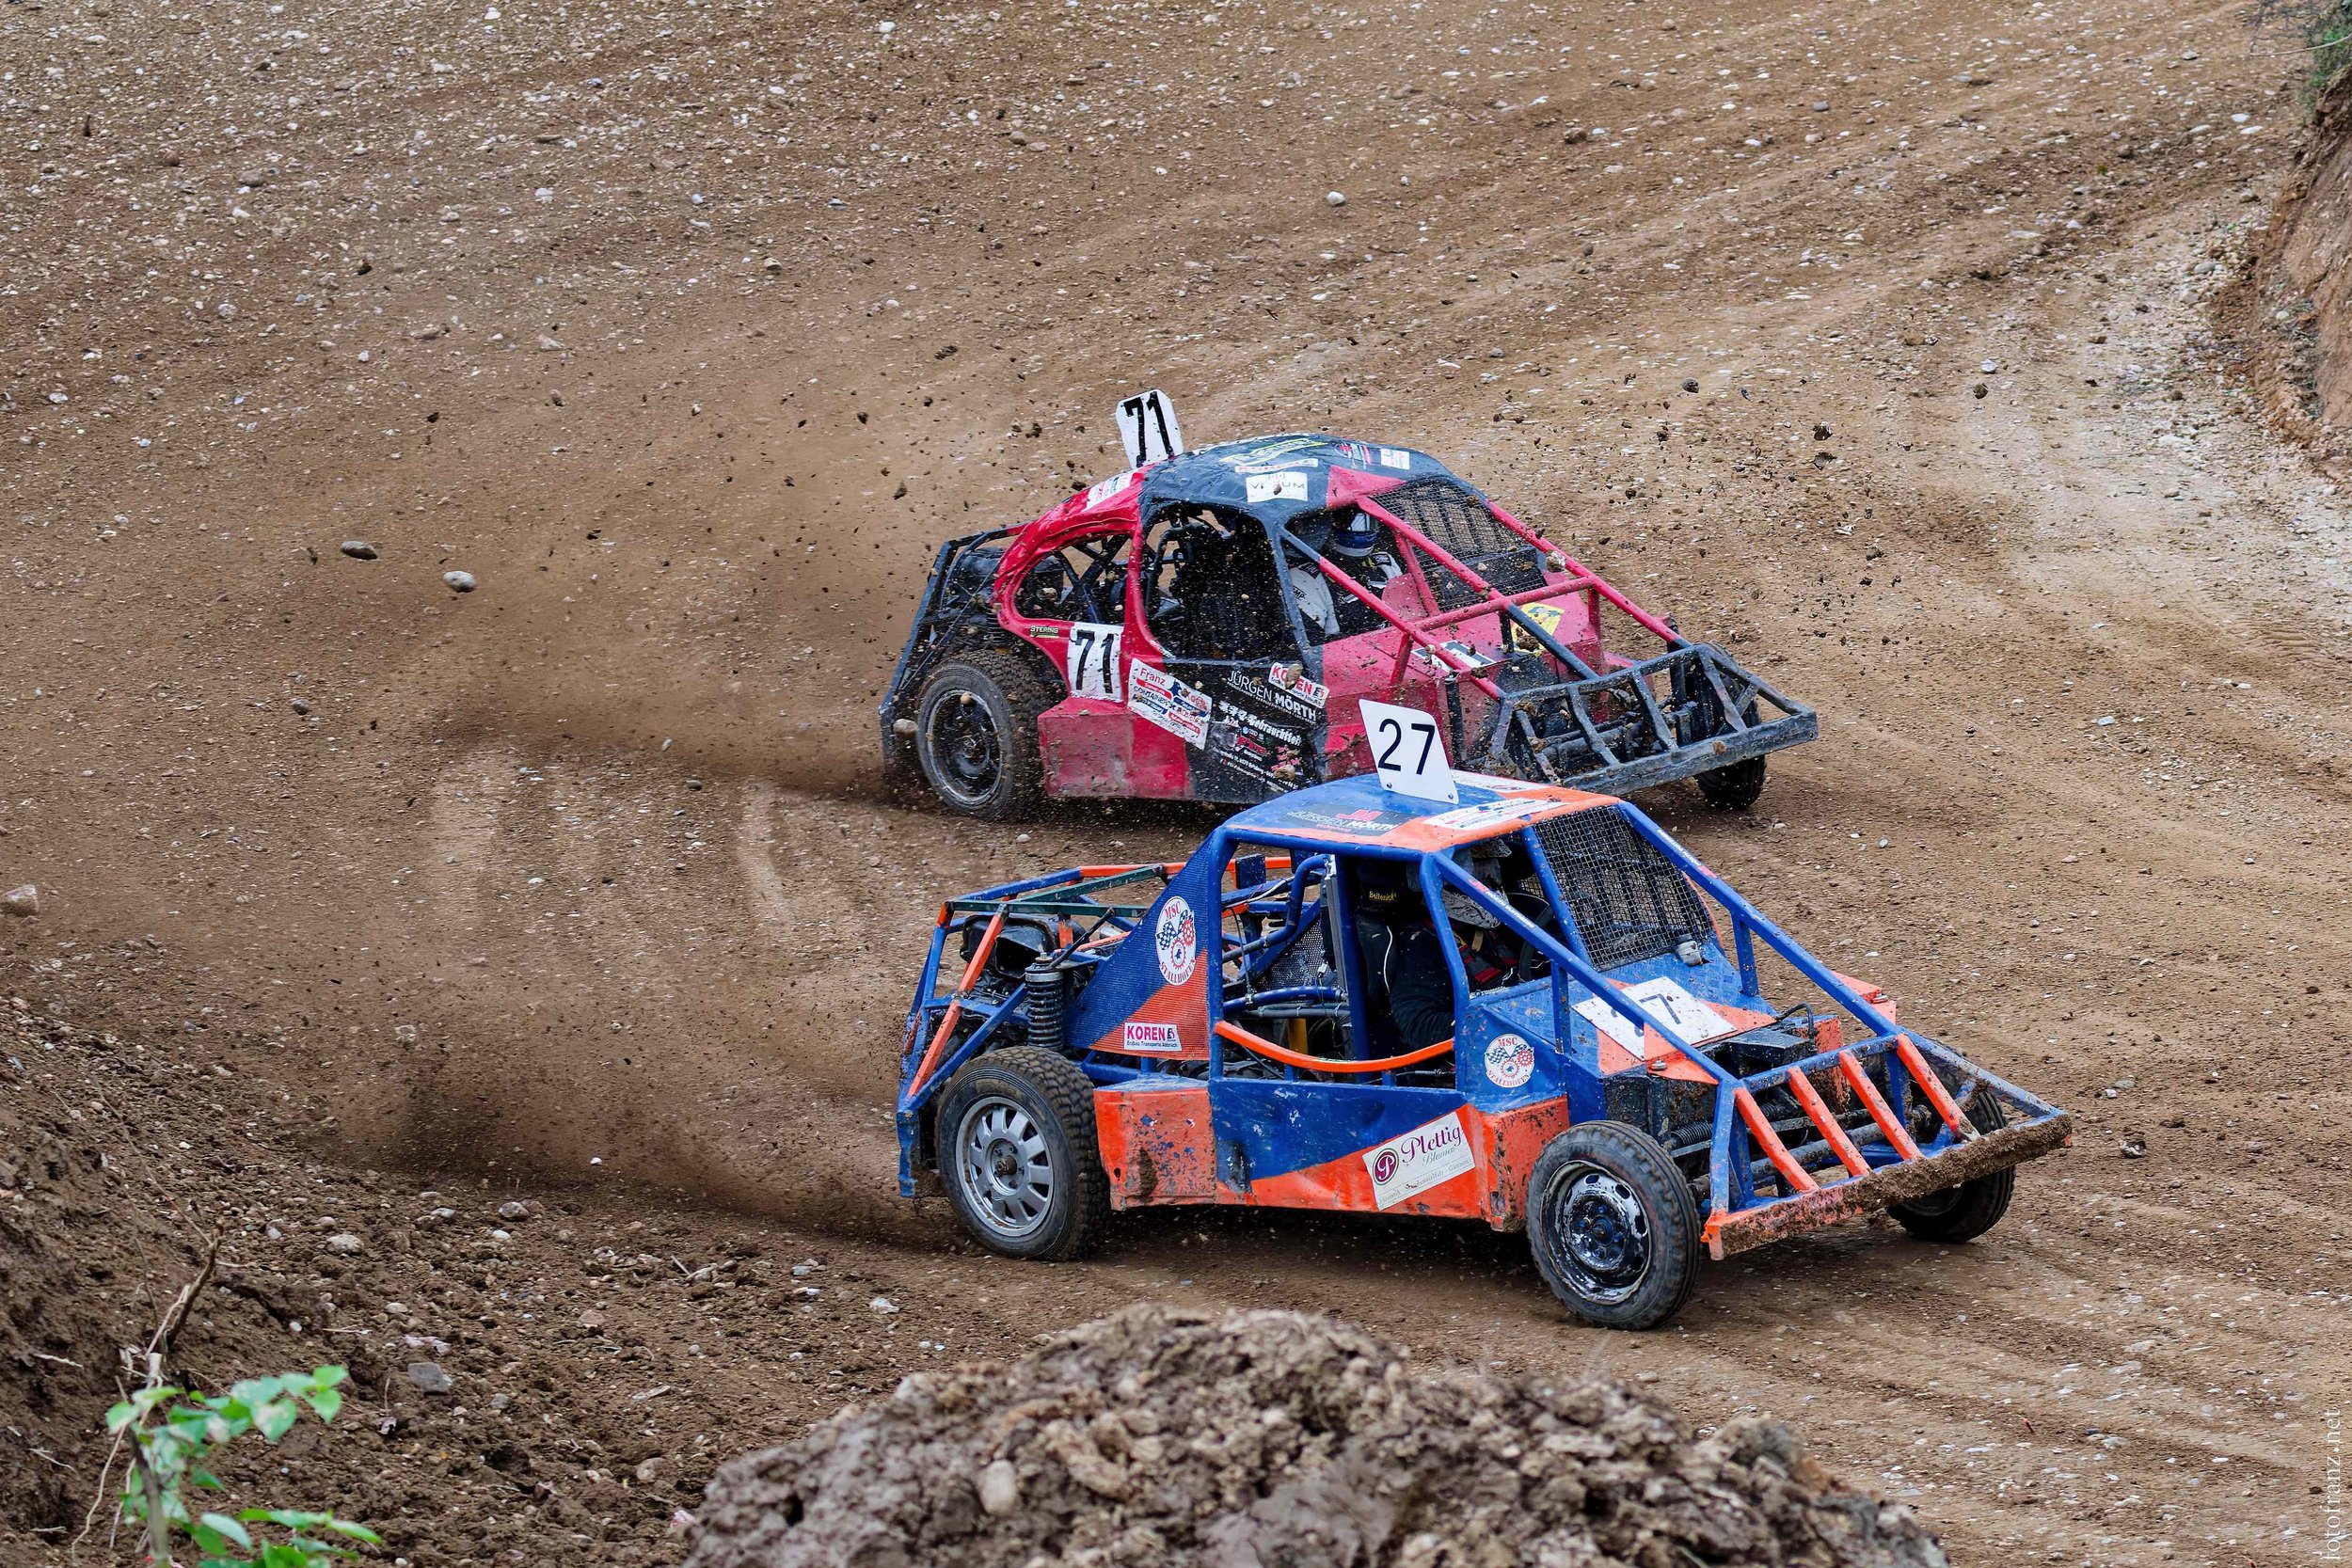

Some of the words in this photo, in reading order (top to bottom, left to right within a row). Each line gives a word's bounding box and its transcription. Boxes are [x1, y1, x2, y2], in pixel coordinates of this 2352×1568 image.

[1123, 391, 1174, 467] 71
[1075, 629, 1114, 694] 71
[1140, 667, 1167, 686] Franz
[1228, 670, 1273, 702] JÜRGEN
[1275, 692, 1317, 721] MÖRTH
[1378, 719, 1436, 776] 27
[1165, 900, 1181, 921] MSC
[1127, 1025, 1166, 1041] KOREN
[1498, 1037, 1518, 1047] MSC
[1401, 1126, 1464, 1164] Plettig
[1422, 1145, 1456, 1166] Blumen
